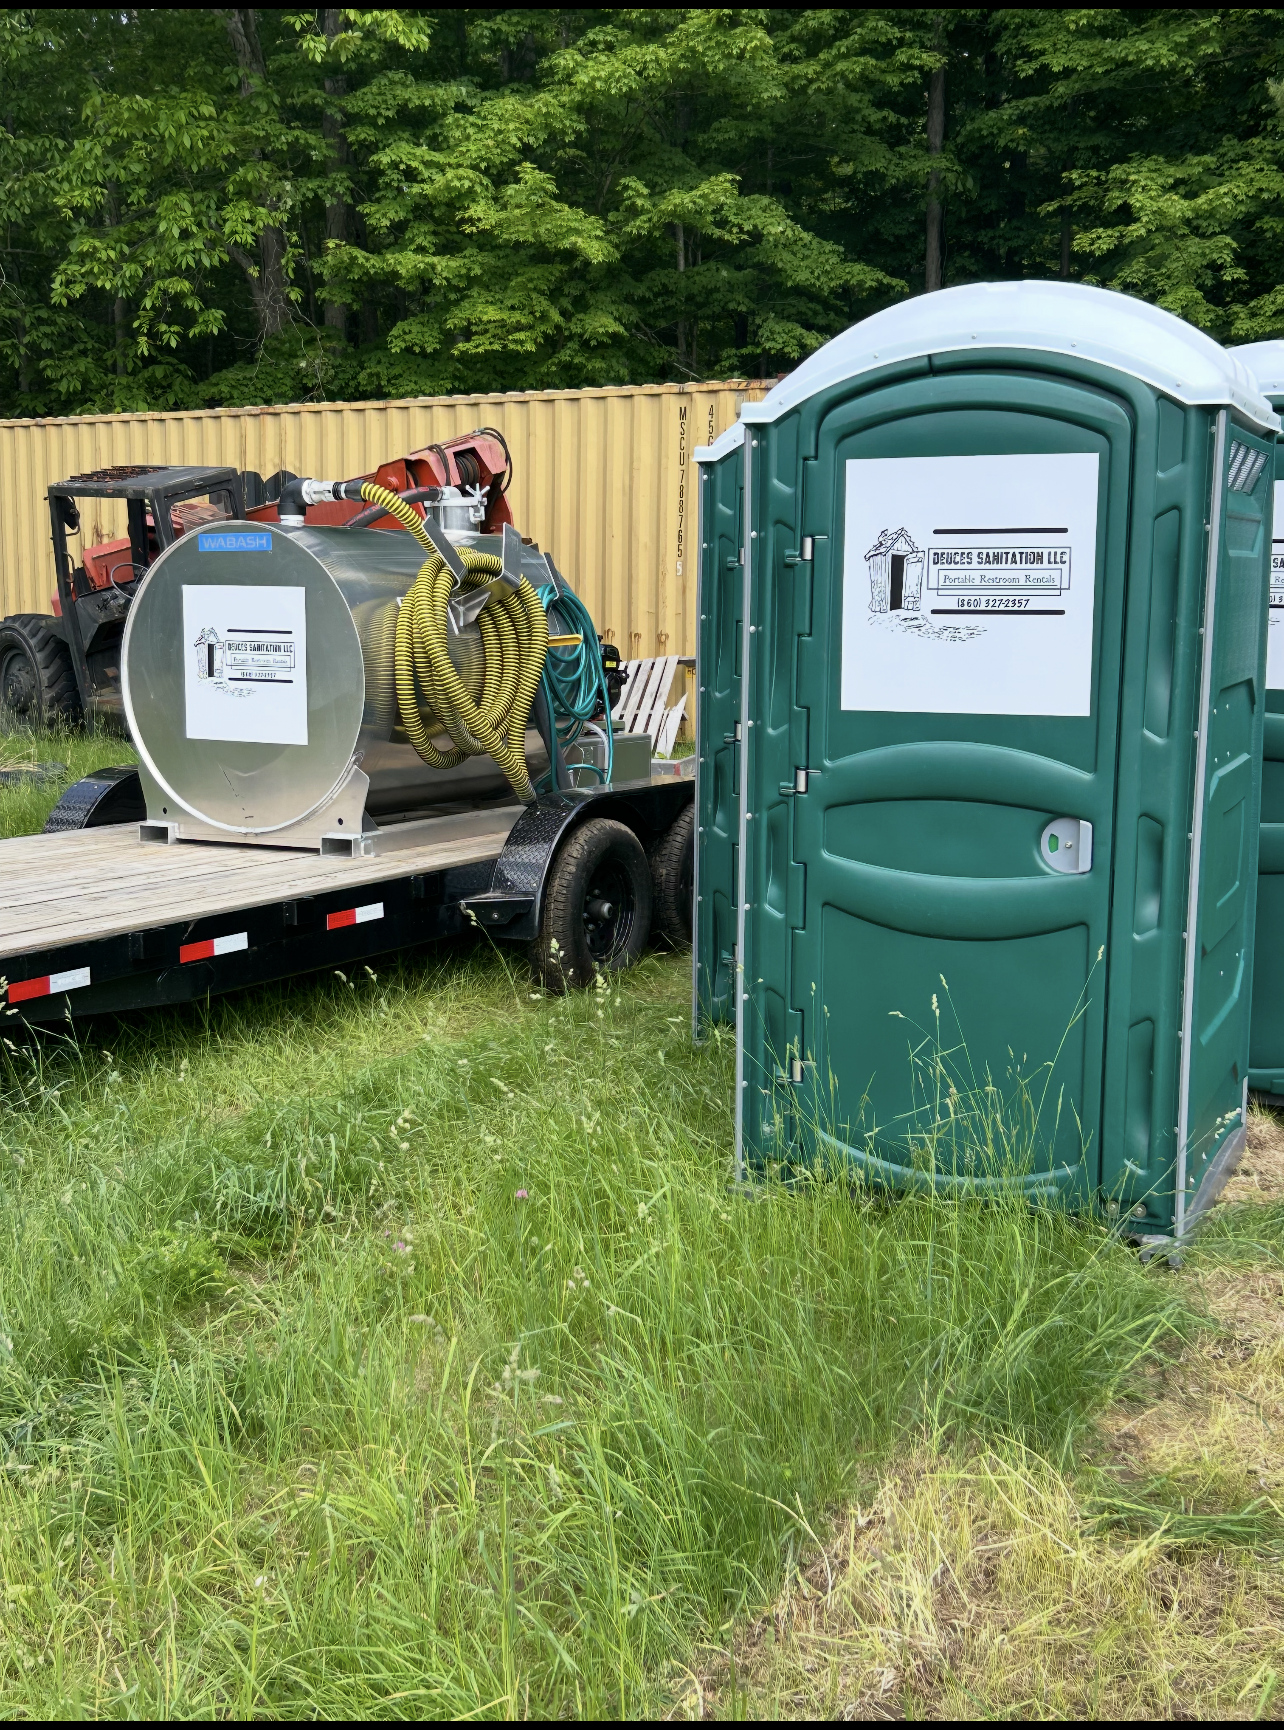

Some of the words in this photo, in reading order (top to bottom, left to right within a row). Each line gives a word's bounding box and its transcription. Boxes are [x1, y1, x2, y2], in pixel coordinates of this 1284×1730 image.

[679, 406, 687, 466] MSCU
[677, 469, 685, 558] 788765
[202, 536, 267, 549] WABASH
[932, 551, 973, 566] DEUCES
[977, 551, 1044, 566] SANITATION
[1047, 550, 1067, 565] LLC
[942, 574, 976, 584] Portable
[979, 575, 1020, 584] Restroom
[1024, 574, 1056, 584] Rentals
[957, 598, 982, 608] (860)
[984, 598, 1031, 609] 327-2357
